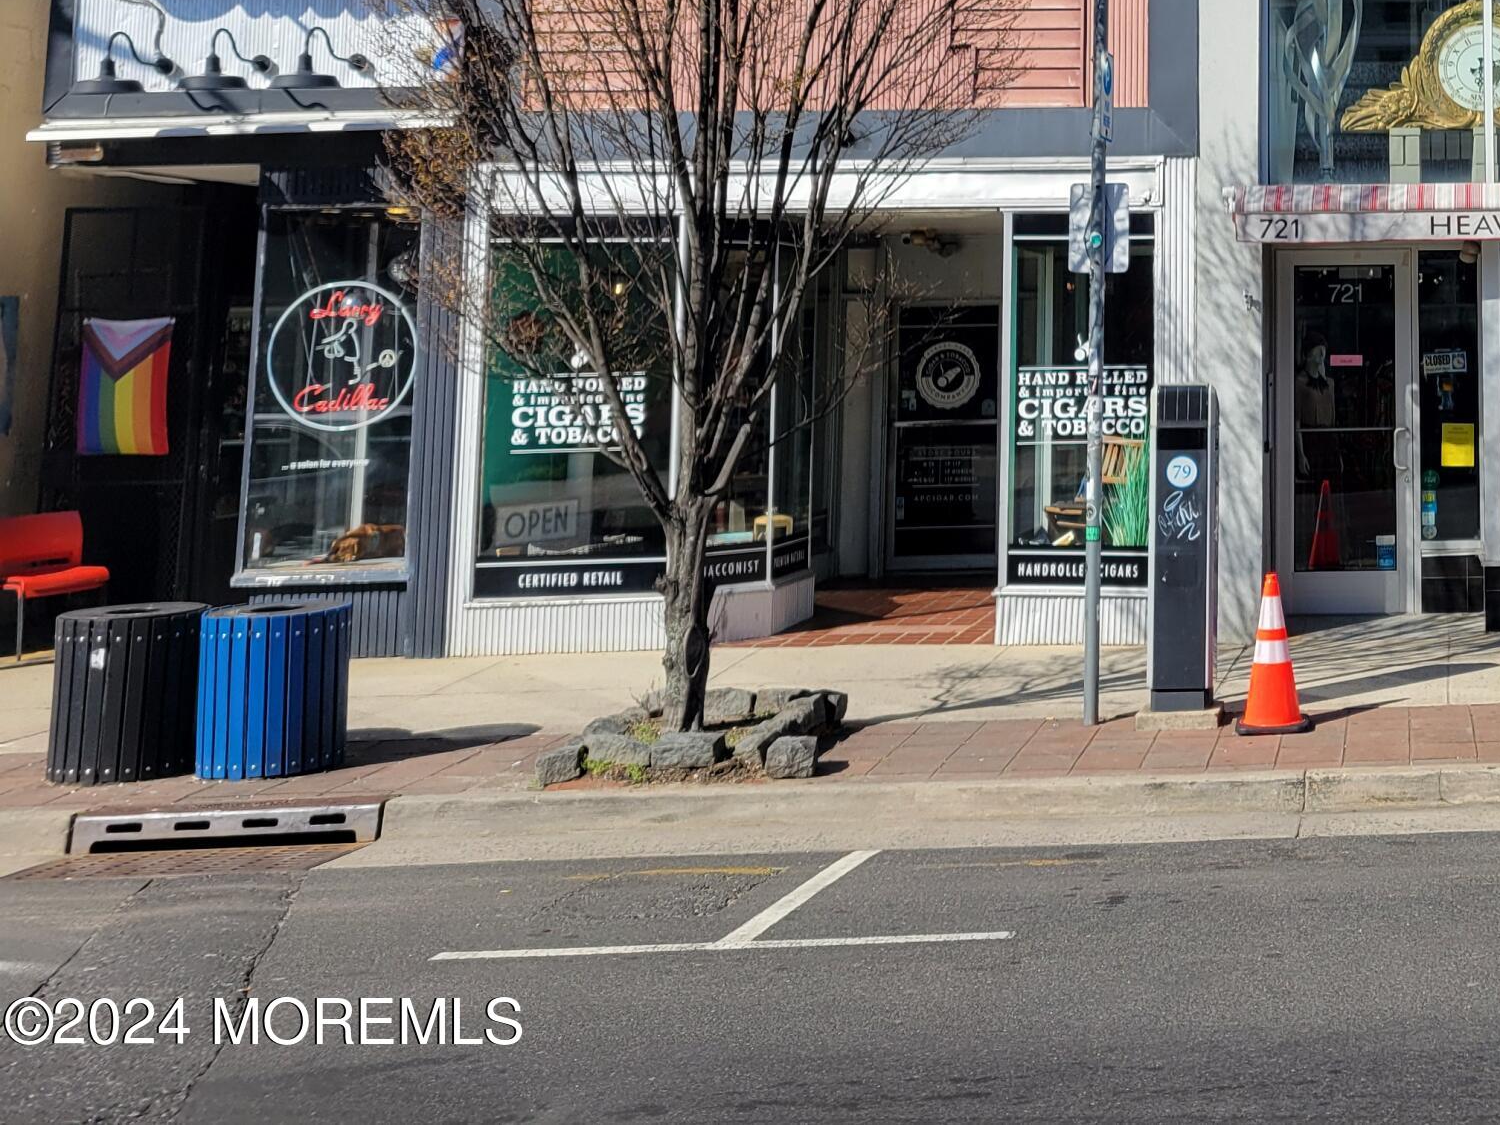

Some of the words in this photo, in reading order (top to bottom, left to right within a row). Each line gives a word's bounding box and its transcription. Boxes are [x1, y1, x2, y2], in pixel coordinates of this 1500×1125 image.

[1260, 218, 1299, 239] 721
[1327, 283, 1362, 303] 721
[309, 290, 384, 326] Larry
[1425, 355, 1451, 366] CLOSED
[1018, 372, 1069, 385] HAND
[1075, 370, 1148, 384] RLLED
[293, 383, 389, 412] Cadillac
[1018, 386, 1030, 398] &
[1035, 385, 1106, 398] import
[1114, 385, 1147, 396] fine
[512, 394, 526, 407] &
[1018, 419, 1034, 436] &
[1041, 418, 1145, 436] TOBCCO
[510, 428, 529, 445] &
[1172, 465, 1191, 479] 79
[504, 506, 569, 538] OPEN
[1018, 562, 1084, 577] HANDROLLE
[518, 572, 578, 588] CERTIFIED
[582, 570, 624, 587] RETAIL
